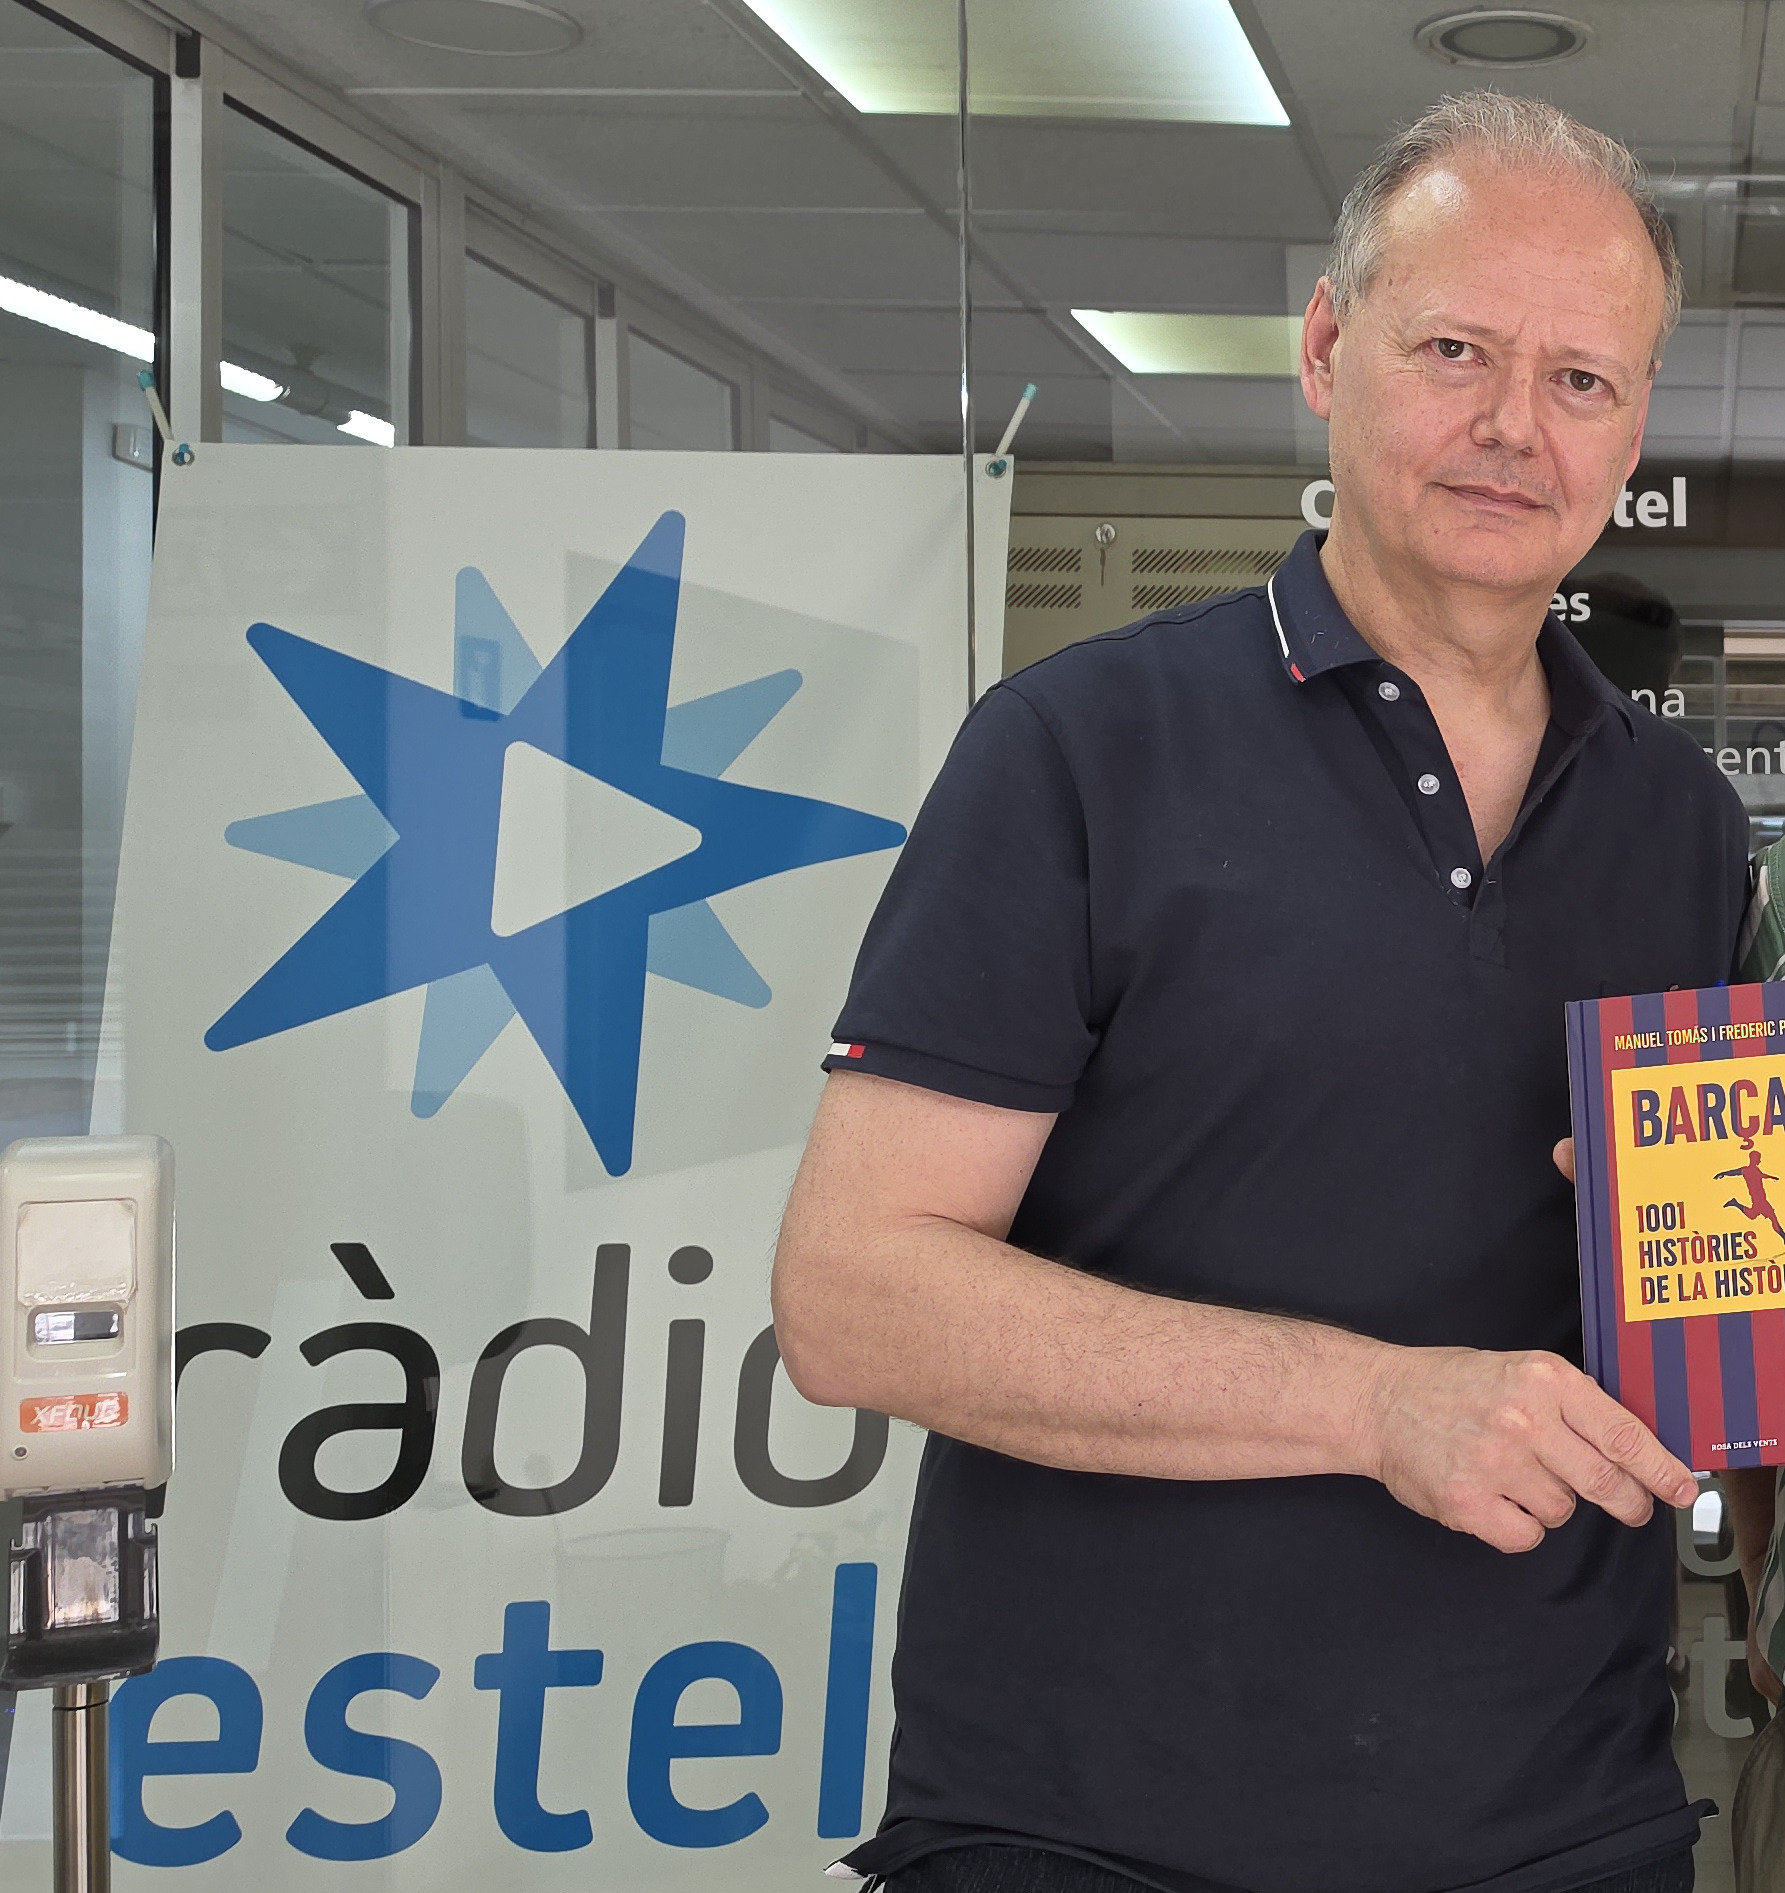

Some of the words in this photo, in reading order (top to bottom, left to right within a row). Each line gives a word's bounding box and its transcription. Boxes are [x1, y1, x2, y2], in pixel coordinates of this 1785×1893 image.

[1614, 1031, 1664, 1051] MANUEL
[1666, 1024, 1708, 1046] TOMÁS
[1711, 1026, 1716, 1042] I
[1719, 1021, 1776, 1041] FREDERIC
[1636, 1201, 1686, 1233] 1001
[1638, 1230, 1758, 1269] HISTÒRIES
[1641, 1275, 1670, 1305] DE
[1677, 1271, 1708, 1302] LA
[147, 1242, 890, 1520] ràdio
[1711, 1443, 1731, 1451] ROSA
[1733, 1441, 1752, 1449] DELS
[1753, 1439, 1778, 1448] VENTS
[109, 1562, 878, 1867] estel
